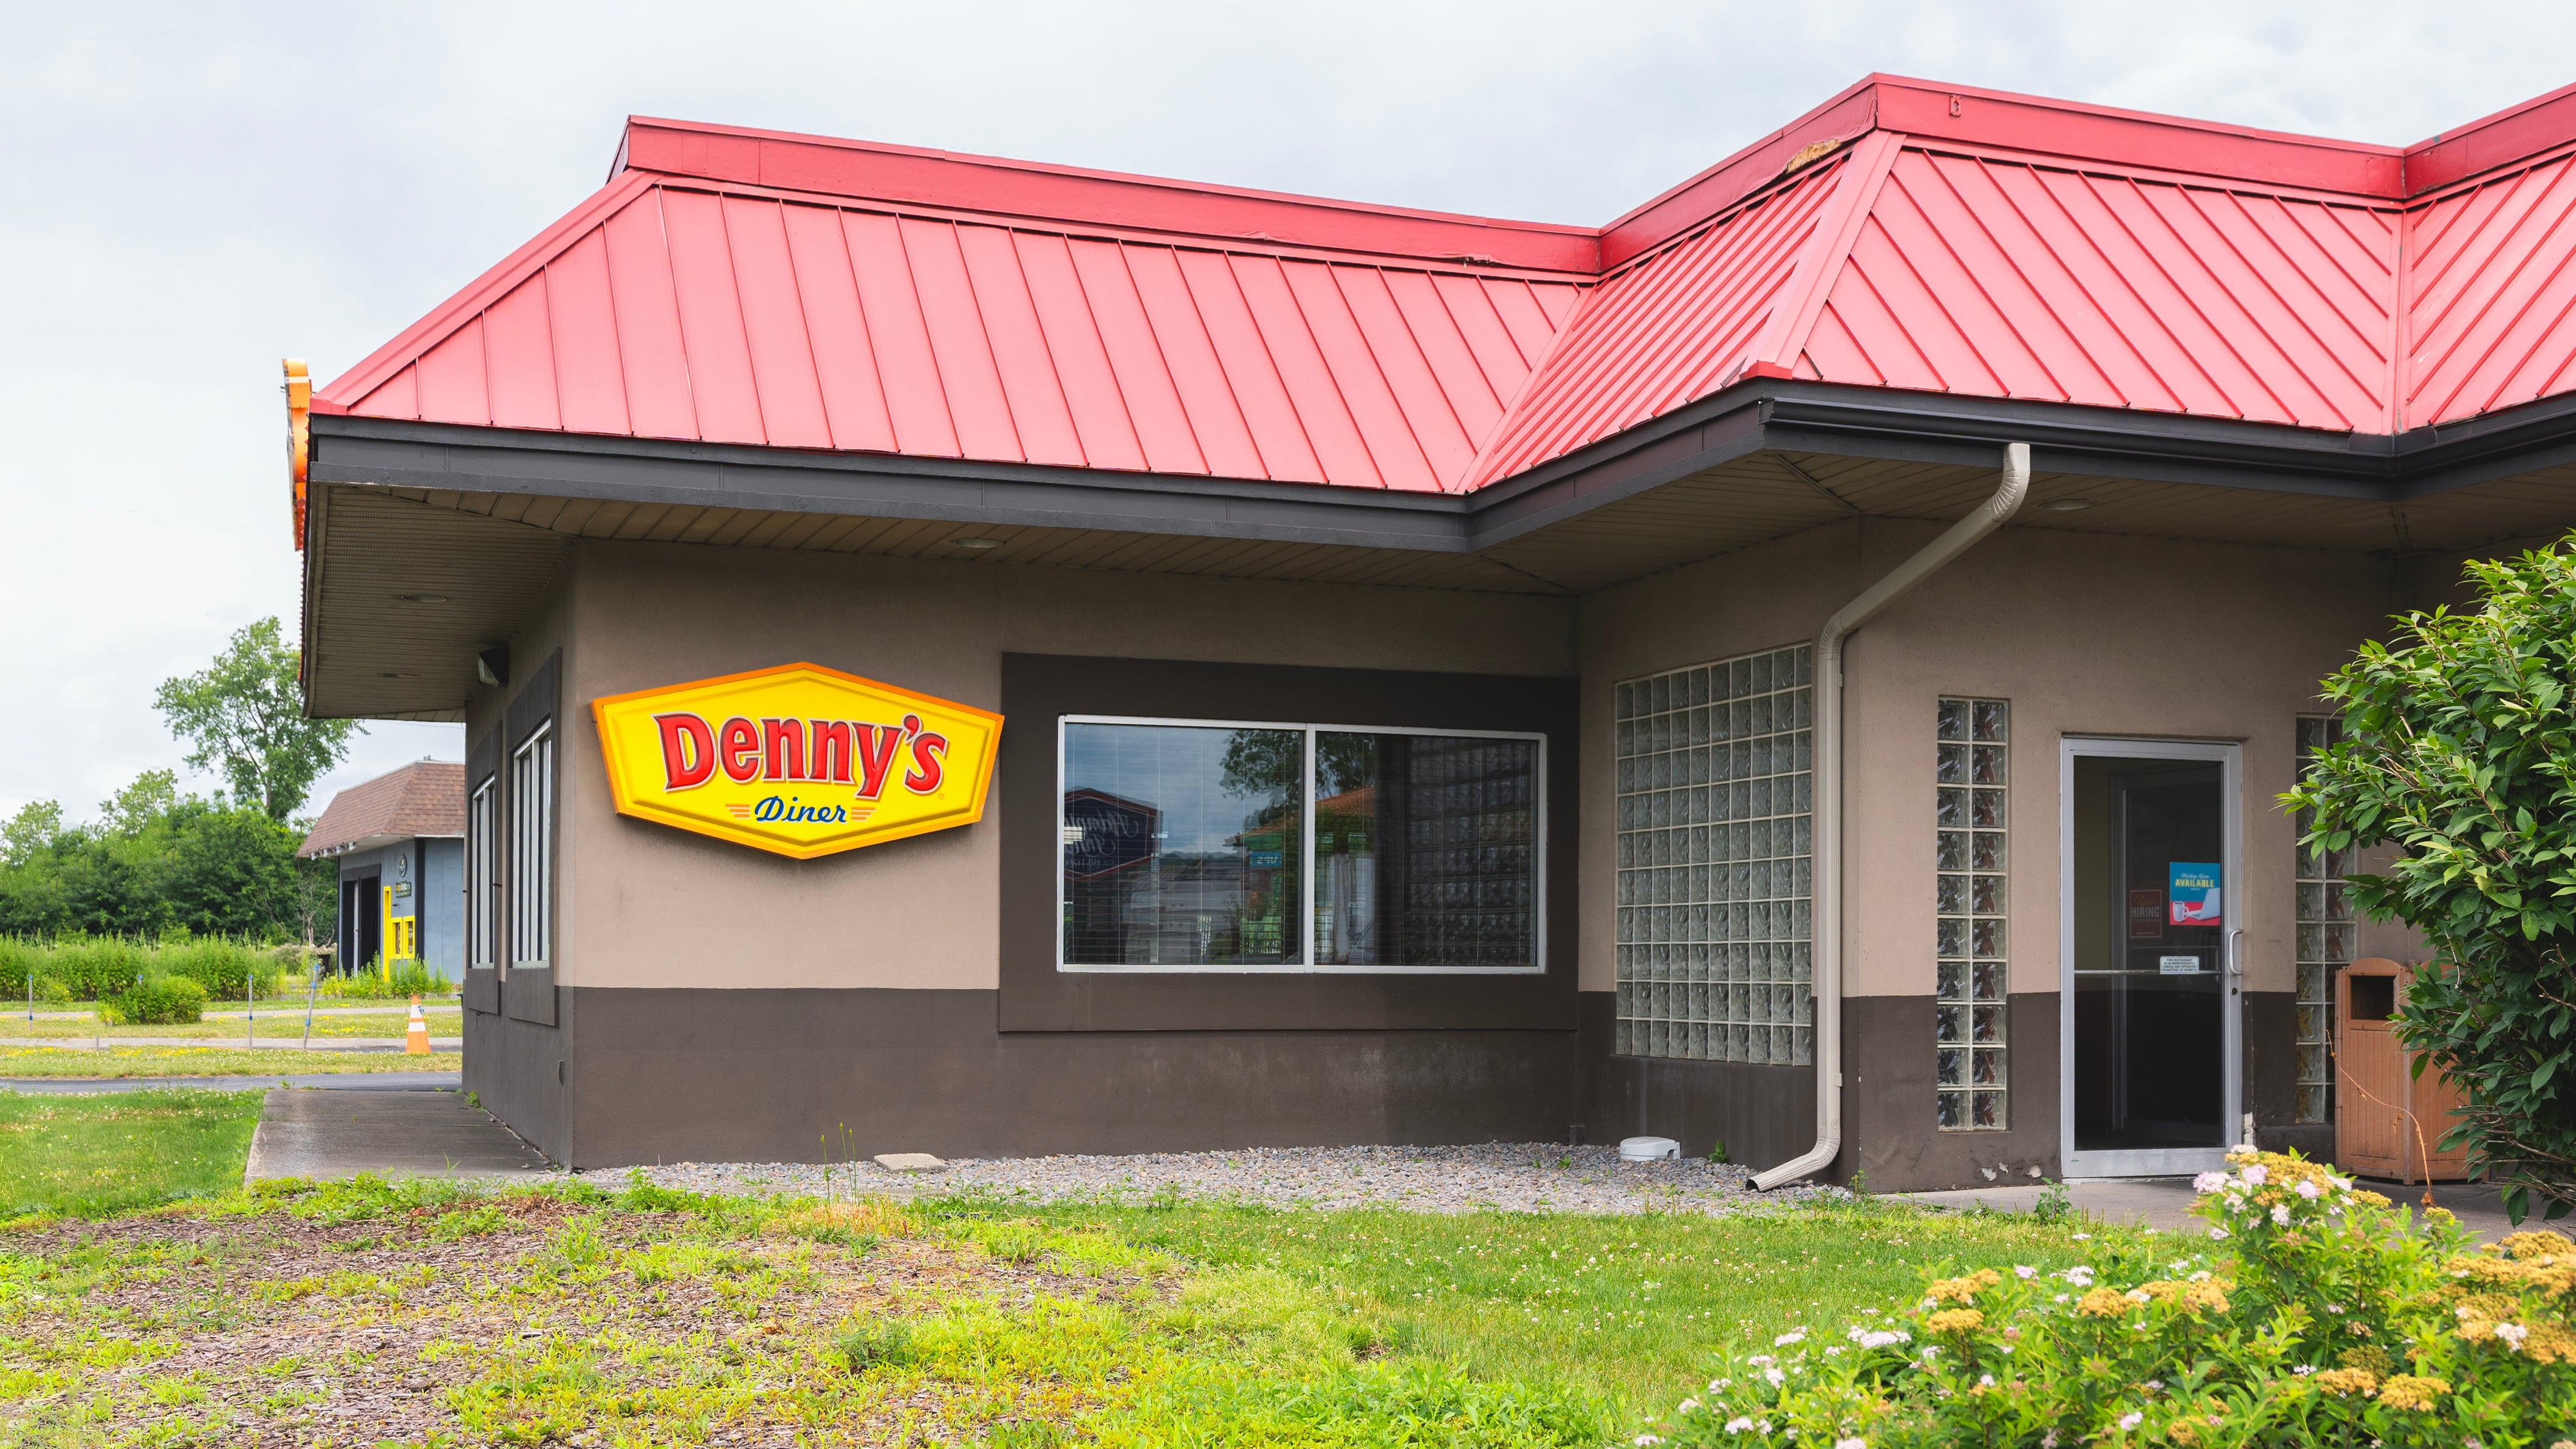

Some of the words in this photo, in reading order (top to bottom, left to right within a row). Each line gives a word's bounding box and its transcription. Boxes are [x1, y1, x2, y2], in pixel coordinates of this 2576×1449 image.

[651, 711, 948, 800] Denny's
[755, 795, 846, 822] Diner
[2175, 879, 2215, 888] AVAILABLE
[2131, 906, 2159, 917] HIRING
